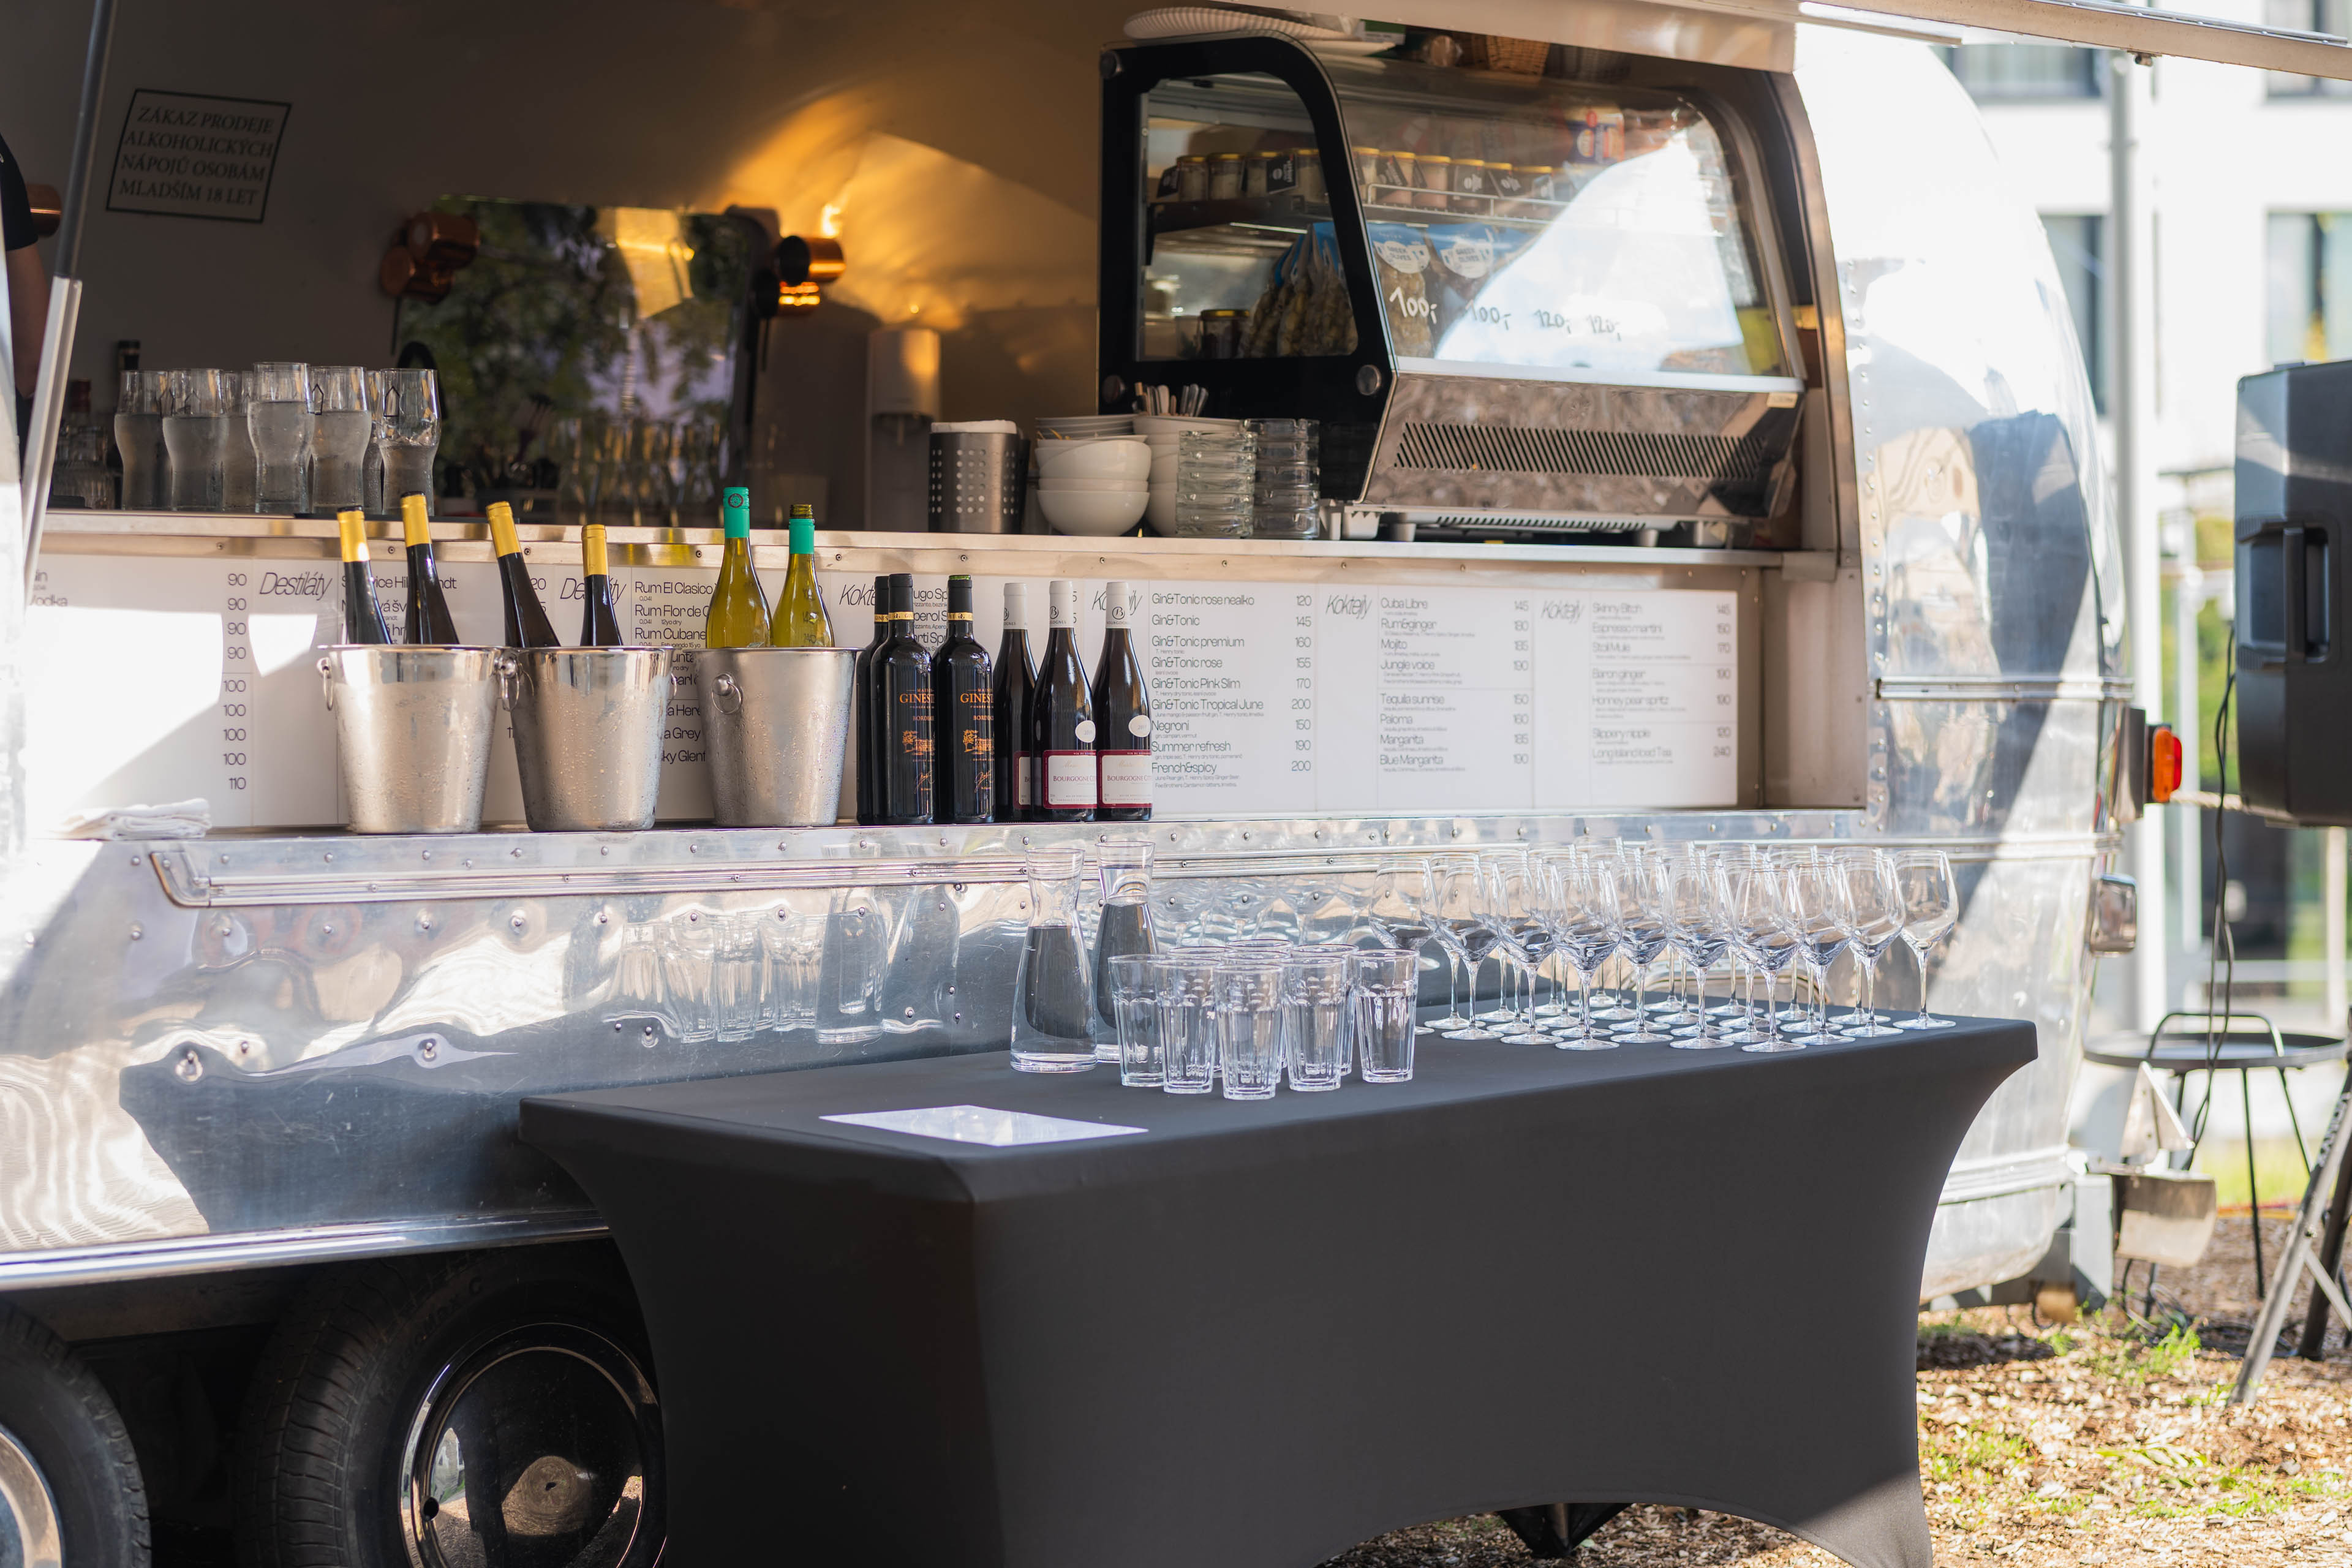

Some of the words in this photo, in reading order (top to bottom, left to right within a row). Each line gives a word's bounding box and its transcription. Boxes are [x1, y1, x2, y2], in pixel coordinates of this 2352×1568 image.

[200, 112, 274, 135] PRODEJE
[206, 187, 221, 202] 18
[226, 189, 258, 205] LET
[228, 573, 247, 586] 90
[259, 571, 333, 601] Destiláty
[635, 581, 662, 594] Rum
[663, 582, 673, 594] El
[674, 582, 713, 594] Clasico
[228, 598, 246, 611] 90
[1152, 593, 1200, 605] Gin&Tonic
[1224, 595, 1254, 605] nealko
[1297, 595, 1312, 606] 120
[635, 605, 662, 616] Rum
[663, 605, 685, 617] Flor
[687, 605, 701, 617] de
[1152, 614, 1200, 625] Gin&Tonic
[1296, 616, 1311, 627] 145
[227, 622, 246, 635] 90
[635, 627, 662, 639] Rum
[1152, 635, 1200, 647] Gin&Tonic
[1200, 637, 1245, 649] premium
[227, 647, 246, 659] 90
[1152, 657, 1200, 668] Gin&Tonic
[1201, 659, 1223, 668] rose
[1297, 657, 1311, 668] 155
[224, 680, 246, 692] 100
[1152, 678, 1199, 689] Gin&Tonic
[1200, 678, 1220, 689] Pink
[1221, 678, 1240, 689] Slim
[1297, 678, 1311, 689] 170
[1152, 699, 1199, 710] Gin&Tonic
[1200, 699, 1238, 712] Tropical
[1239, 699, 1264, 710] June
[1292, 699, 1311, 709] 200
[224, 704, 246, 717] 100
[1152, 720, 1189, 733] Negroni
[1296, 719, 1311, 730] 150
[224, 728, 246, 741] 100
[673, 727, 701, 741] Grey
[1152, 741, 1194, 752] Summer
[1196, 741, 1231, 752] refresh
[1295, 740, 1311, 751] 190
[224, 753, 246, 765] 100
[1152, 762, 1217, 775] French&spicy
[1292, 761, 1311, 771] 200
[229, 777, 246, 790] 110
